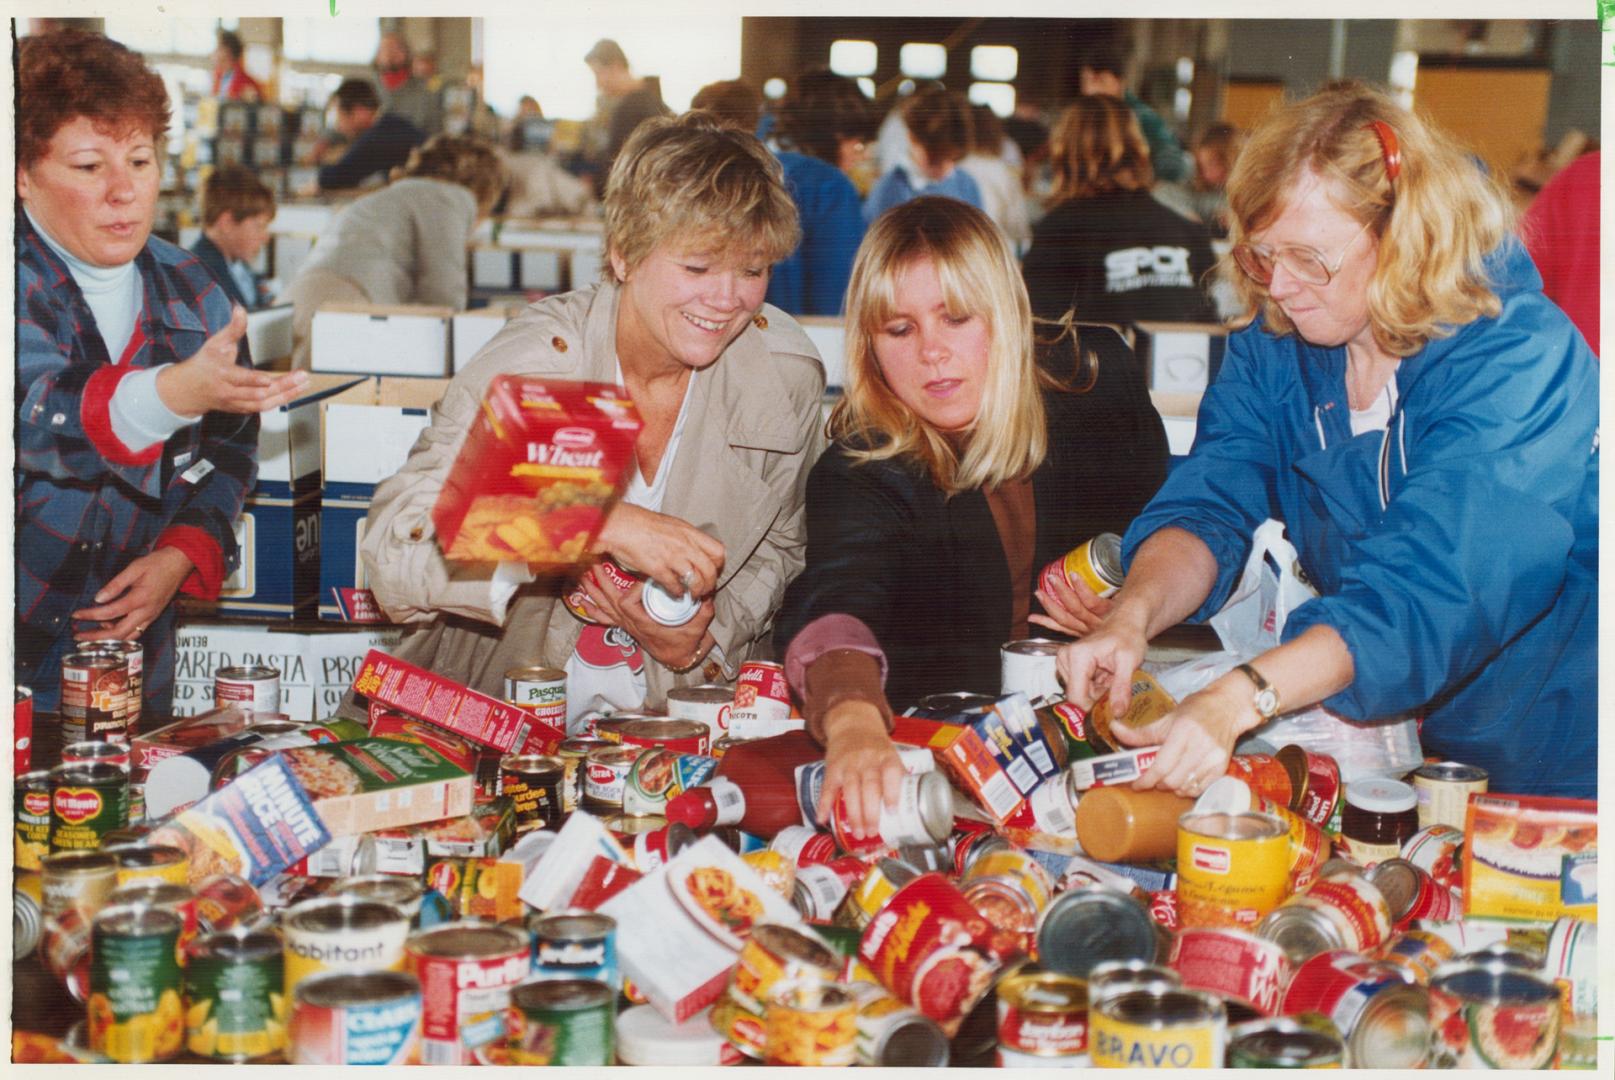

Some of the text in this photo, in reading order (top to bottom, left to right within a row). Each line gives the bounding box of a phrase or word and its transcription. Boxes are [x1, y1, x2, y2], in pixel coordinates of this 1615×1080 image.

[527, 442, 604, 468] Wheat
[238, 775, 285, 830] RICE
[262, 764, 322, 848] MINUTE
[1097, 1029, 1193, 1067] BRAVO
